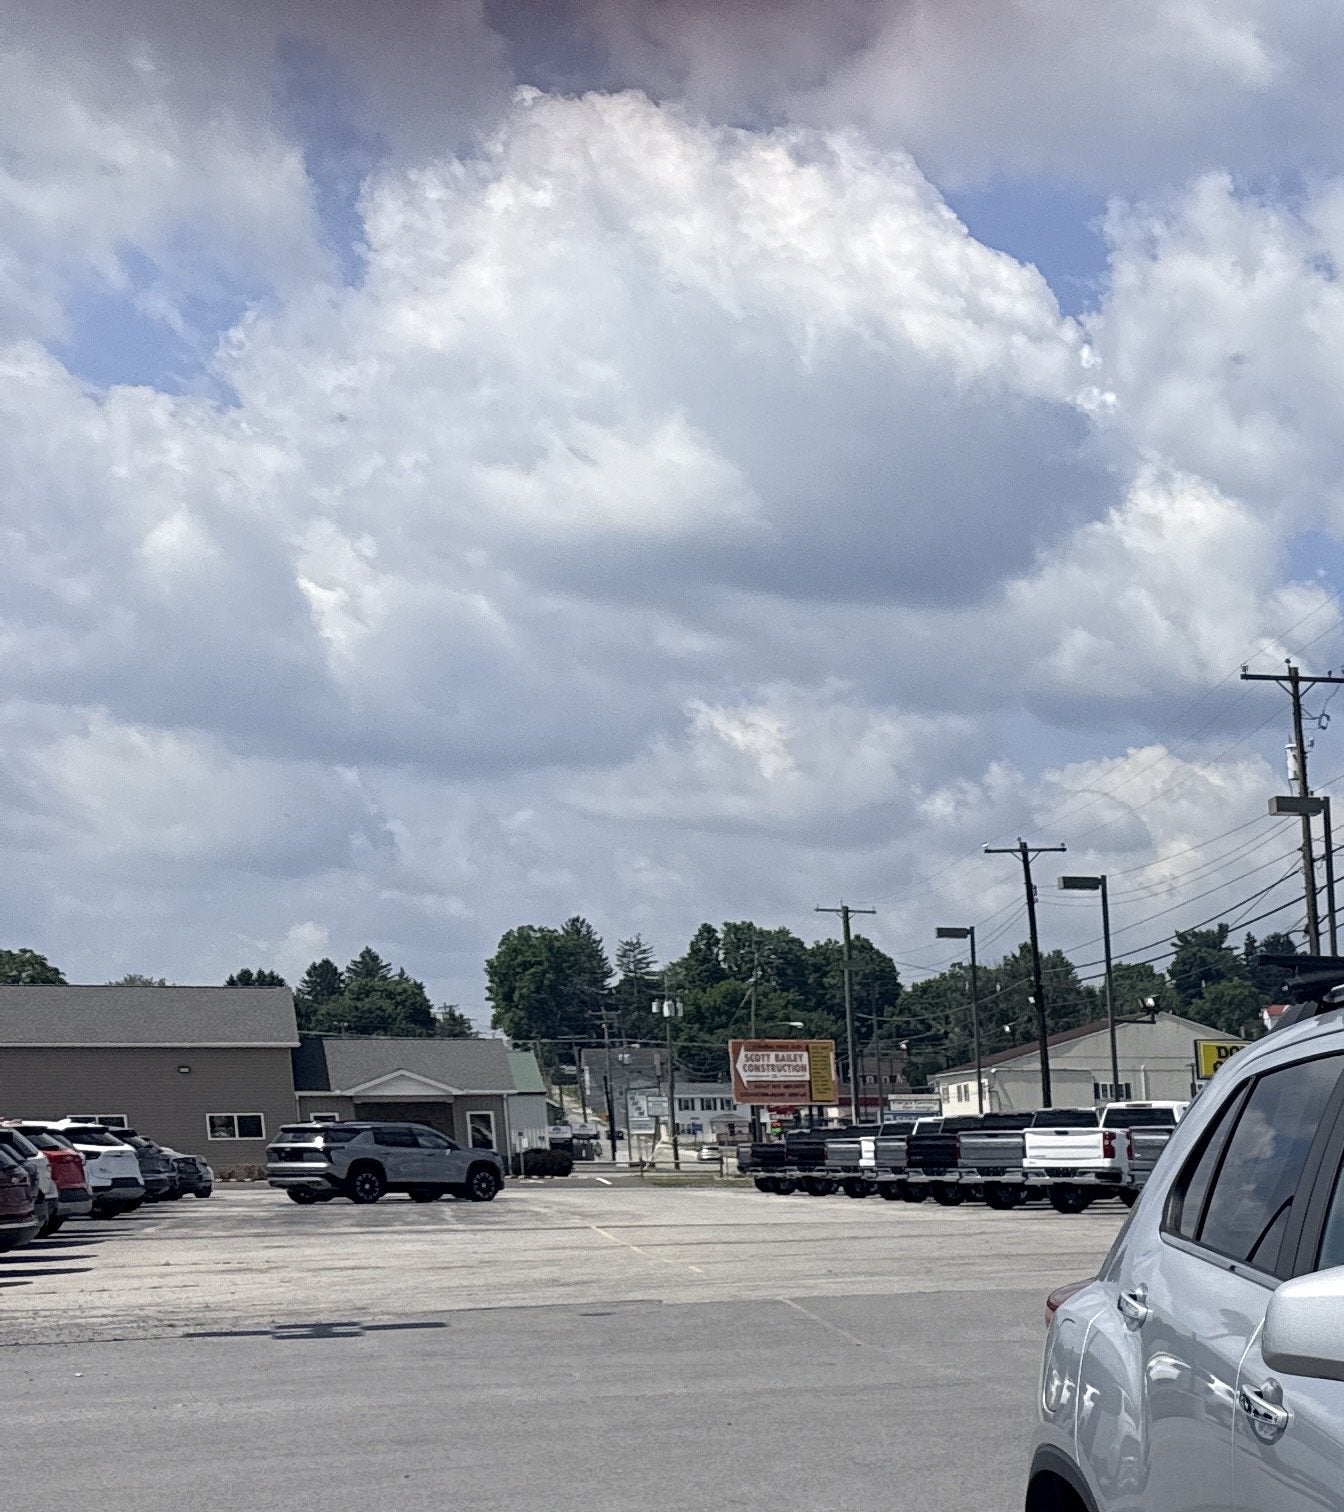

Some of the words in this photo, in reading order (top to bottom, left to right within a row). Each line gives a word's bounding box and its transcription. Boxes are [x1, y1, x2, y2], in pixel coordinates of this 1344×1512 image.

[744, 1053, 771, 1063] SCOTT
[774, 1053, 804, 1063] BAILEY
[743, 1063, 807, 1073] CONSTRUCTION
